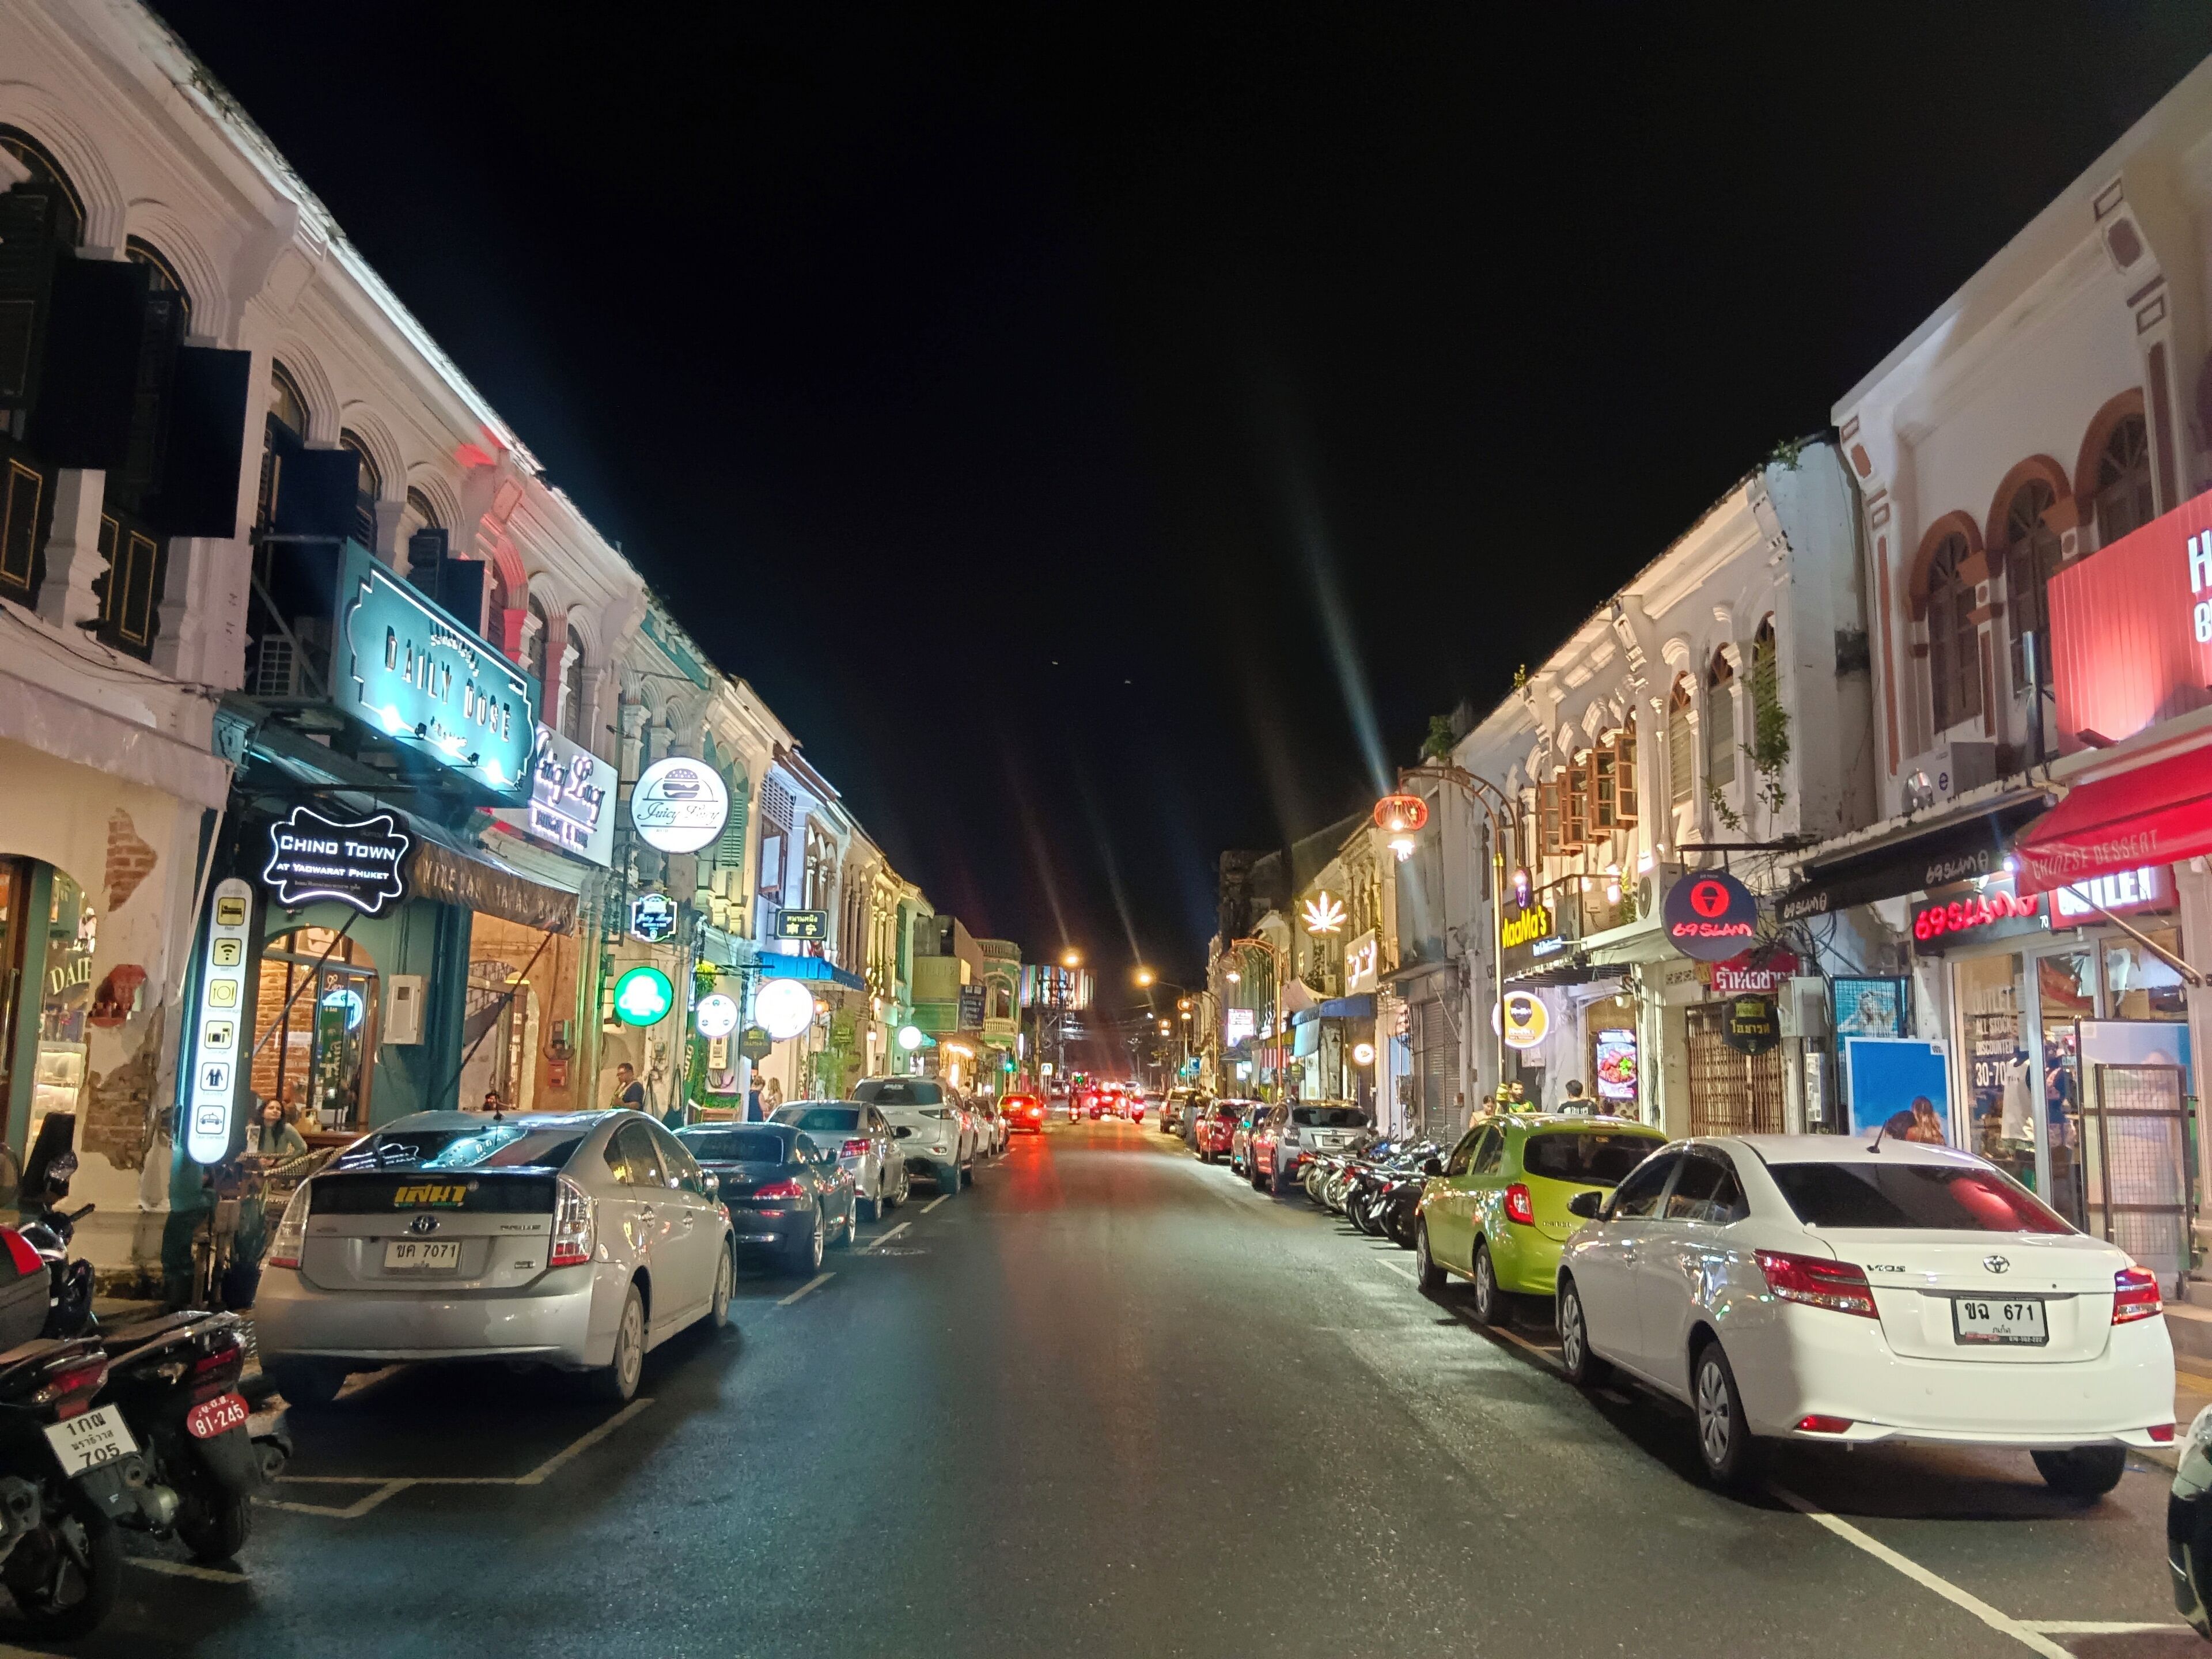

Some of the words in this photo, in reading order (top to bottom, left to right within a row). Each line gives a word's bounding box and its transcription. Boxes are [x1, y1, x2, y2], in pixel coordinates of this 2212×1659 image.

[385, 635, 452, 705] DAILY
[463, 684, 511, 743] DOSE
[637, 802, 680, 824] Juicy
[685, 804, 719, 825] Ly
[2032, 847, 2090, 880] CHINESE
[2093, 829, 2157, 865] DESSERT
[1502, 905, 1547, 949] MaaMa's
[1976, 1039, 2014, 1056] DISCOUNTED
[423, 1244, 456, 1258] 7071
[1965, 1302, 1989, 1320] ขฉ
[2004, 1304, 2033, 1321] 671
[79, 1442, 120, 1468] 705
